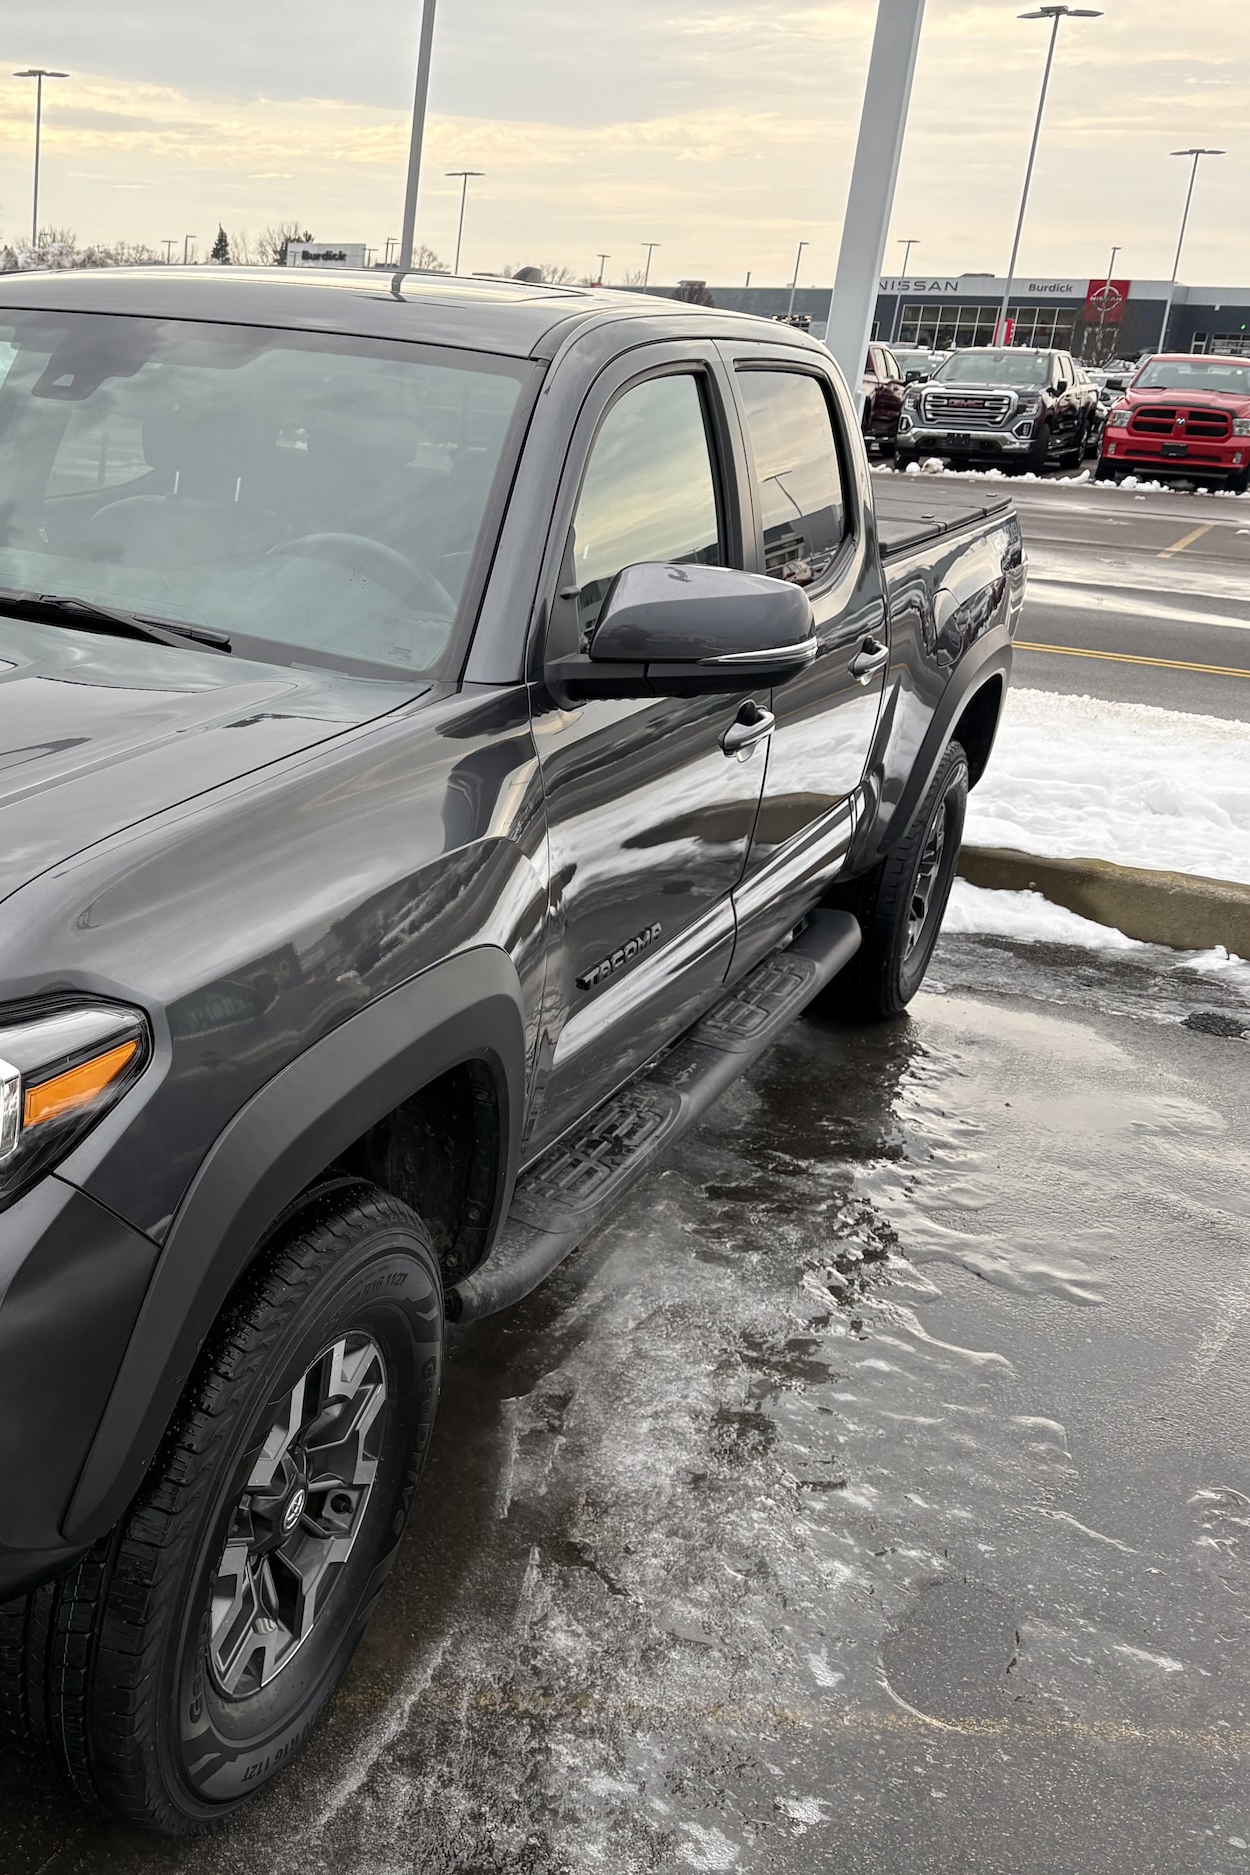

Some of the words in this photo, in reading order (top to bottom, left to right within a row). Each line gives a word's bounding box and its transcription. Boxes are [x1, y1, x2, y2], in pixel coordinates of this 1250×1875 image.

[301, 250, 347, 262] Burdick
[879, 280, 959, 292] NISSAN
[1028, 283, 1073, 294] Burdick
[576, 922, 662, 990] TACOMA
